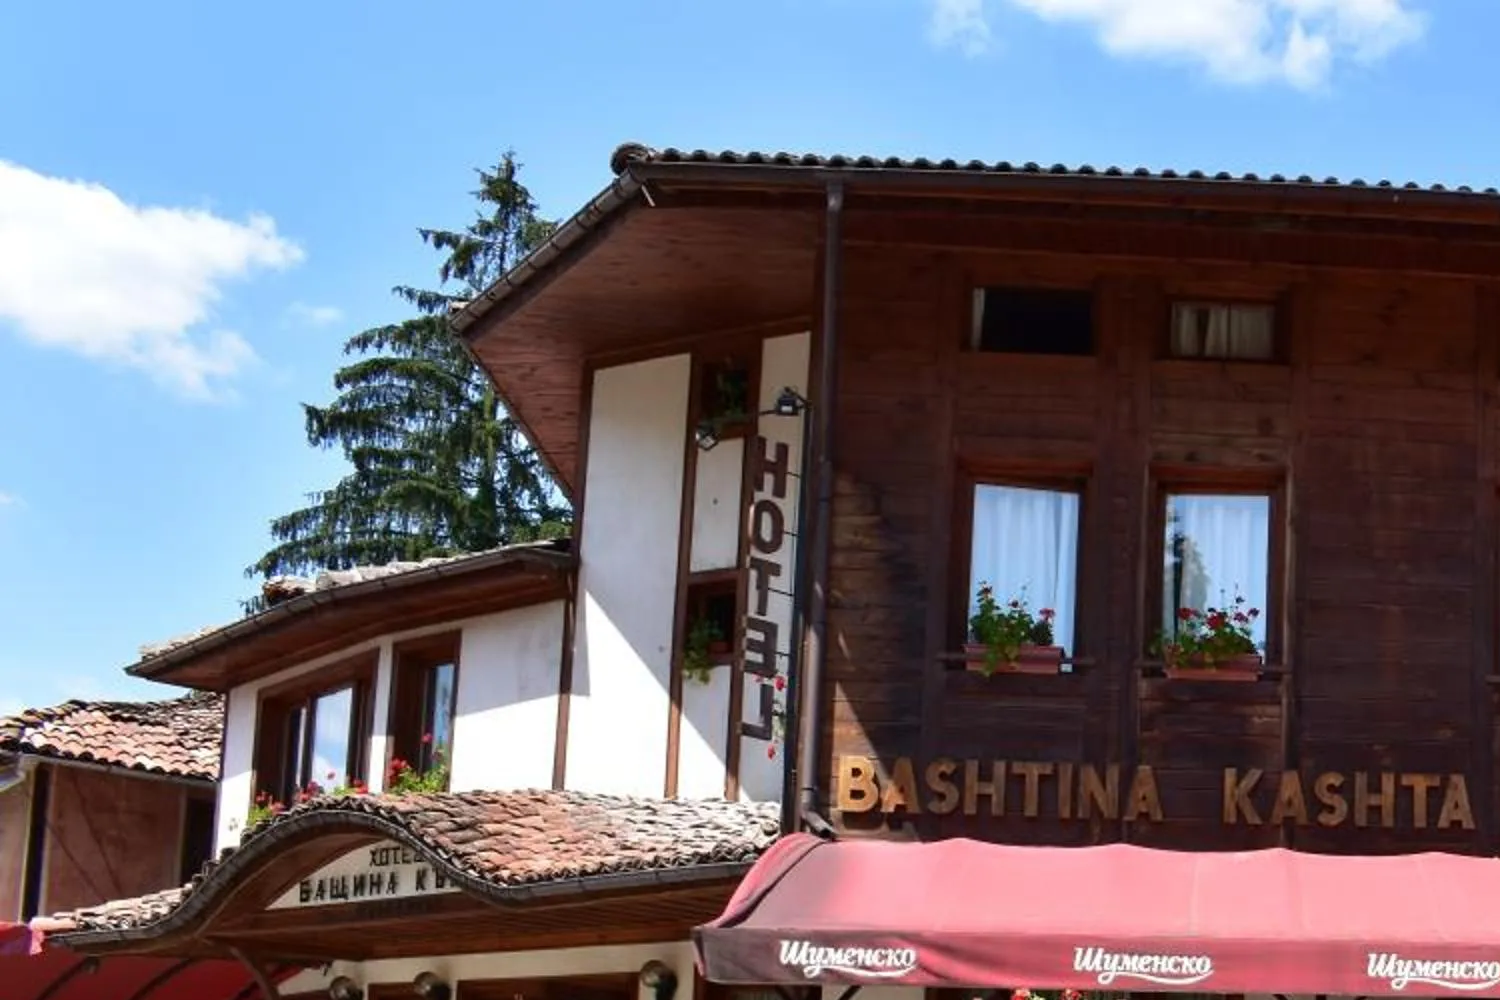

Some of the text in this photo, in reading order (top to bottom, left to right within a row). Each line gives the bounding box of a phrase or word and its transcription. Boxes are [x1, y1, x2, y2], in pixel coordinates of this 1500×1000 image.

[837, 755, 1476, 830] BASHTINA KASHTA
[300, 867, 458, 902] БАЩИНА КЪ
[779, 940, 917, 978] Шуменско
[1073, 947, 1213, 985] Шуменско
